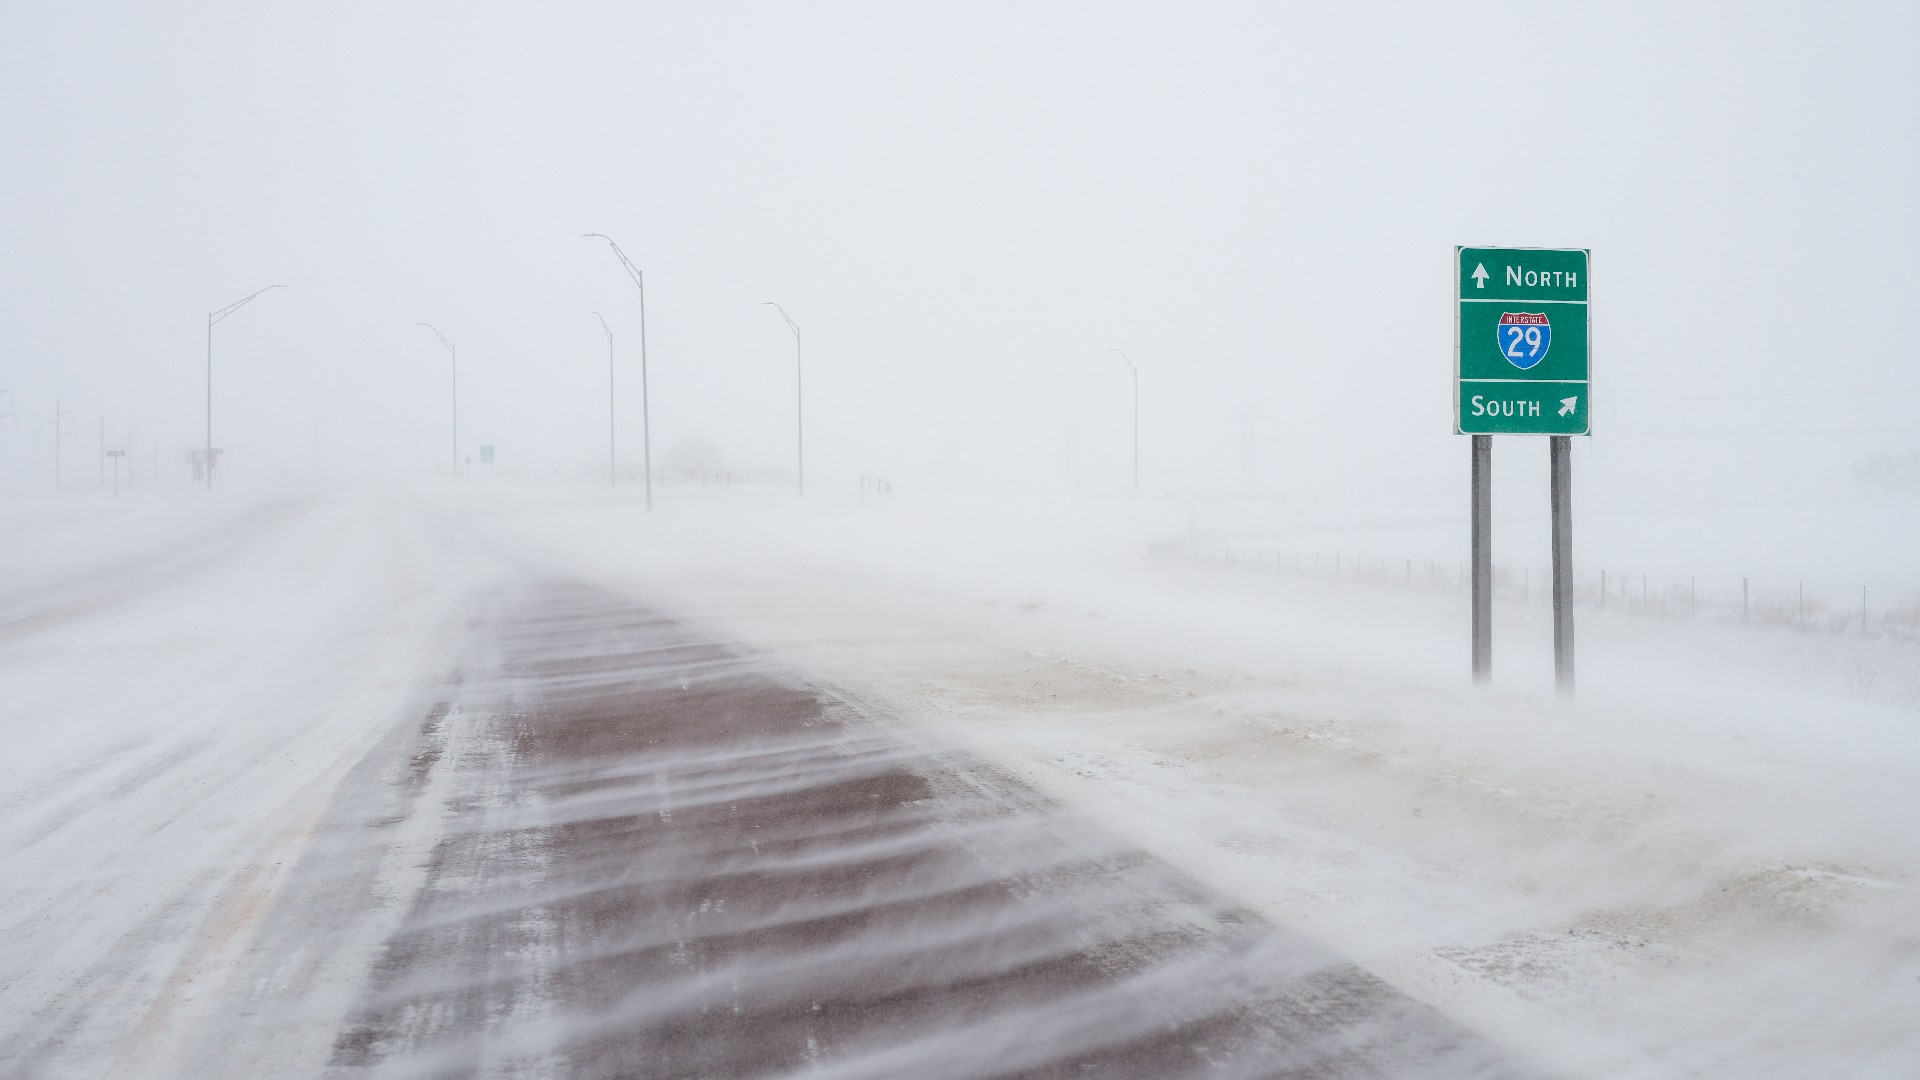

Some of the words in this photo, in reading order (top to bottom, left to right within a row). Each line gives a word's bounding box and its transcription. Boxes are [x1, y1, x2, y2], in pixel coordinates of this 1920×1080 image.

[1506, 265, 1577, 288] NORTH
[1506, 315, 1543, 324] INTERSTATE
[1507, 326, 1541, 358] 29
[1471, 395, 1540, 417] SOUTH
